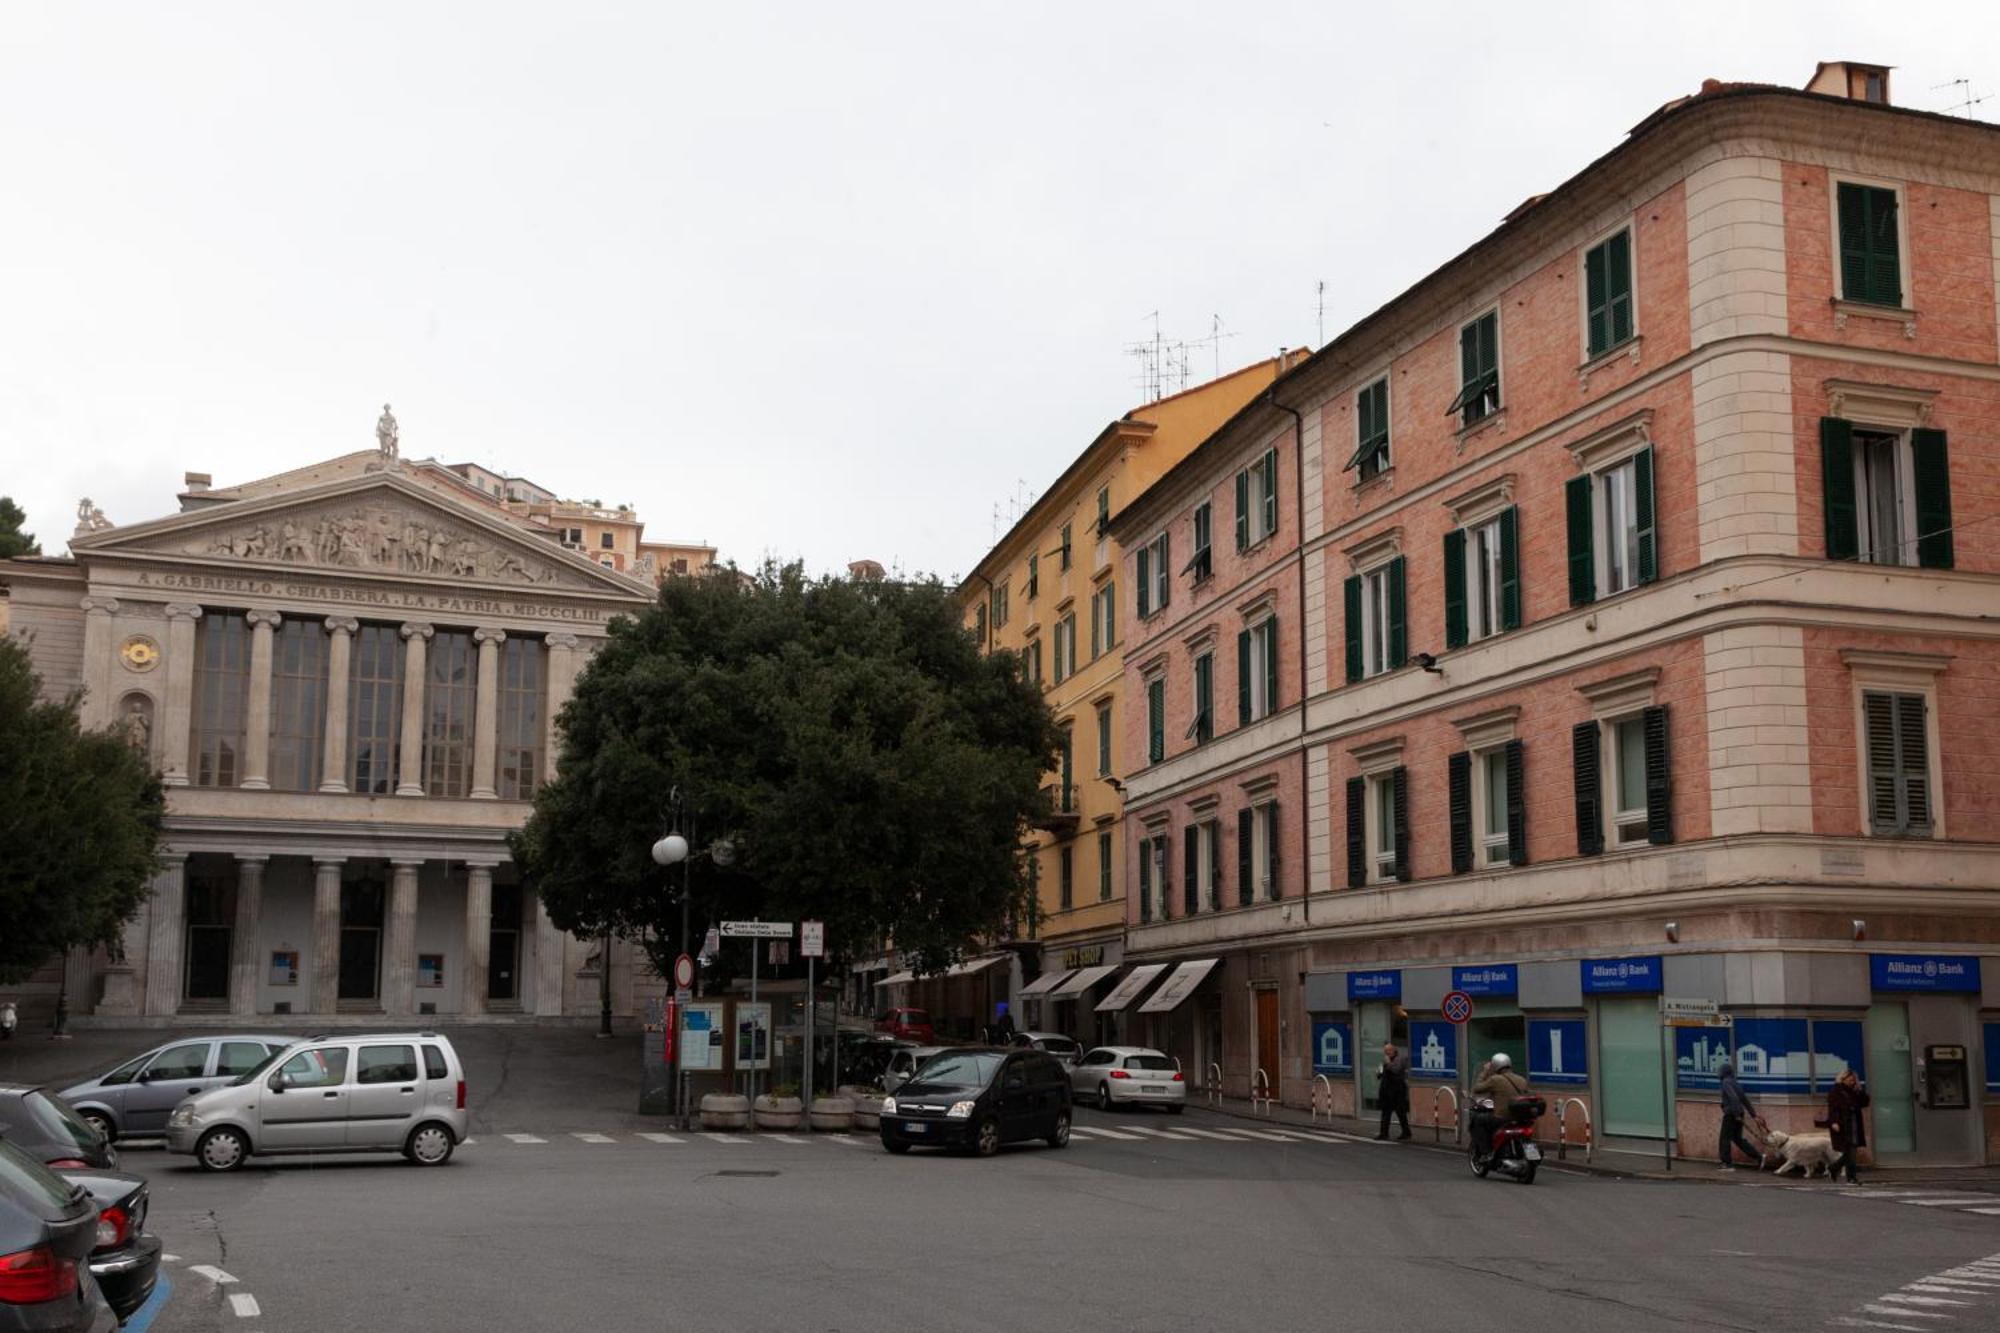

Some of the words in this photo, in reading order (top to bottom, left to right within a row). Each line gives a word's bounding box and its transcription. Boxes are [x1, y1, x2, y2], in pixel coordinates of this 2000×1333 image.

[164, 575, 272, 594] GABRIELLO
[286, 585, 390, 604] CHIABRERA
[403, 594, 426, 608] LA
[439, 598, 502, 614] PATRIA
[1592, 965, 1617, 977] Allianz
[1629, 963, 1649, 976] Bank
[1888, 962, 1922, 974] Allianz
[1938, 963, 1964, 975] Bank
